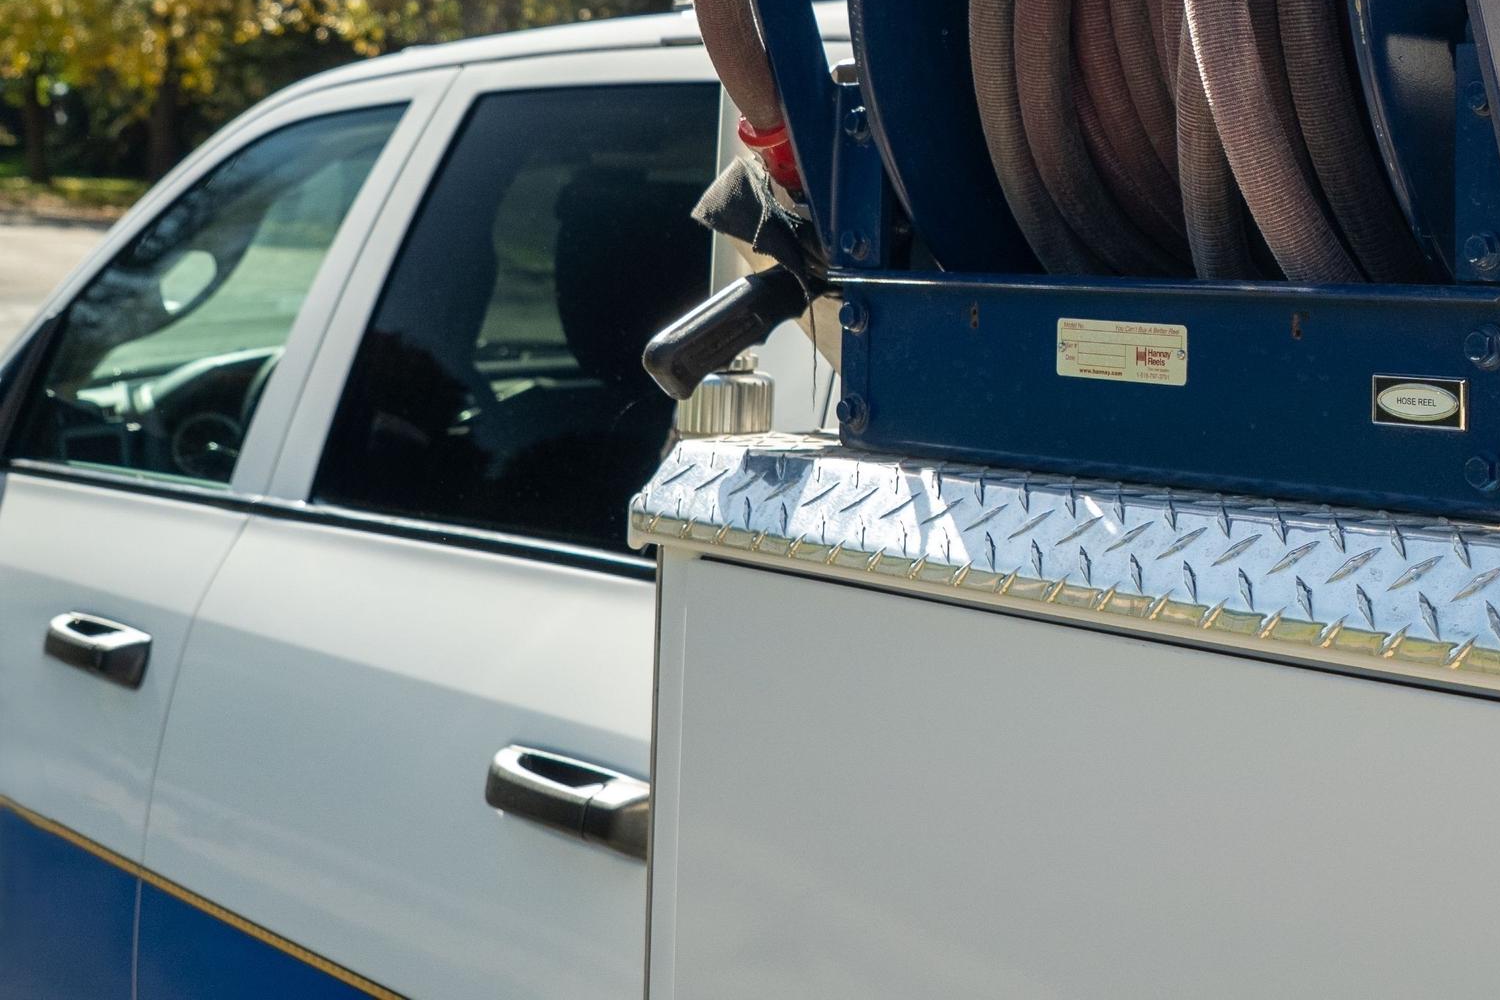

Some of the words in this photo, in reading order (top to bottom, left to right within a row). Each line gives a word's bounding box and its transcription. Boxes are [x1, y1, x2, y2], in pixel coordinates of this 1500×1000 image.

[1147, 349, 1171, 360] Hannay
[1147, 358, 1166, 366] Reels
[1079, 367, 1123, 377] www.hannay.com
[1396, 396, 1416, 406] HOSE
[1418, 398, 1437, 407] REEL
